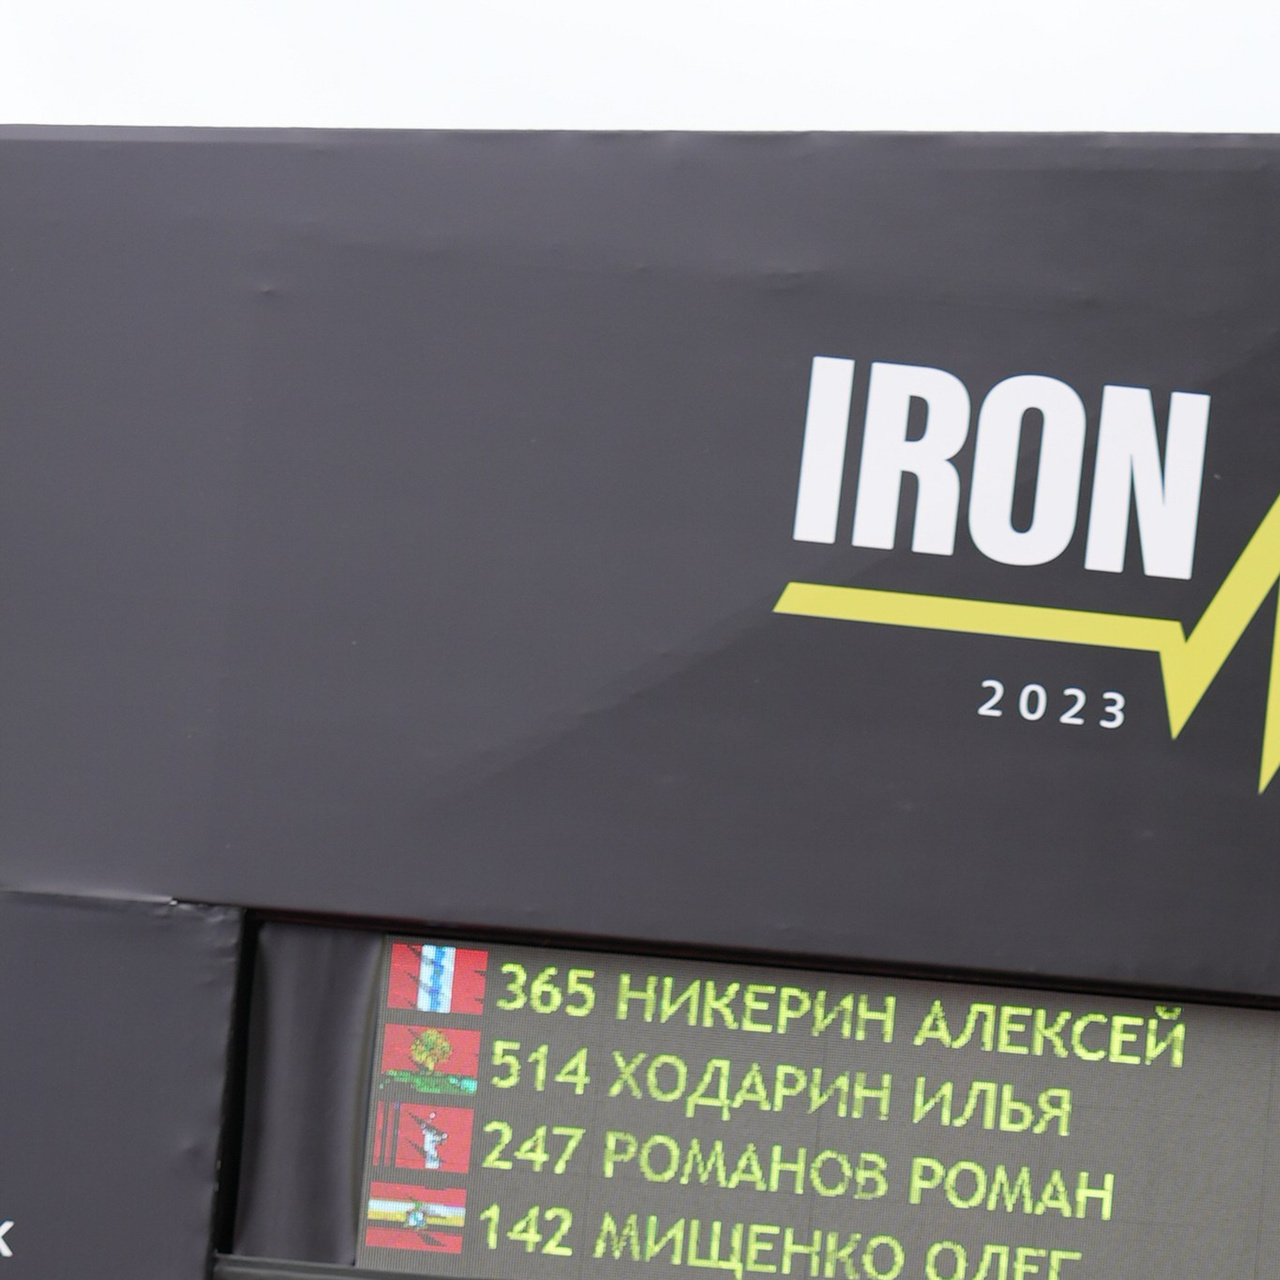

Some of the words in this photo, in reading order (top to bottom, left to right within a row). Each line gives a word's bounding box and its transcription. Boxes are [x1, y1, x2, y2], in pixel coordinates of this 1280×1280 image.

[794, 355, 1211, 580] IRON
[977, 679, 1128, 730] 2023
[496, 962, 597, 1018] 365
[615, 972, 896, 1044] НИКЕРИН
[912, 997, 1187, 1068] АЛЕКСЕЙ
[490, 1041, 591, 1096] 514
[608, 1050, 893, 1120] ХОДАРИН
[912, 1074, 1073, 1137] ИЛЬЯ
[482, 1120, 586, 1175] 247
[602, 1130, 889, 1202] РОМАНОВ
[908, 1156, 1116, 1222] РОМАН
[478, 1205, 574, 1258] 142
